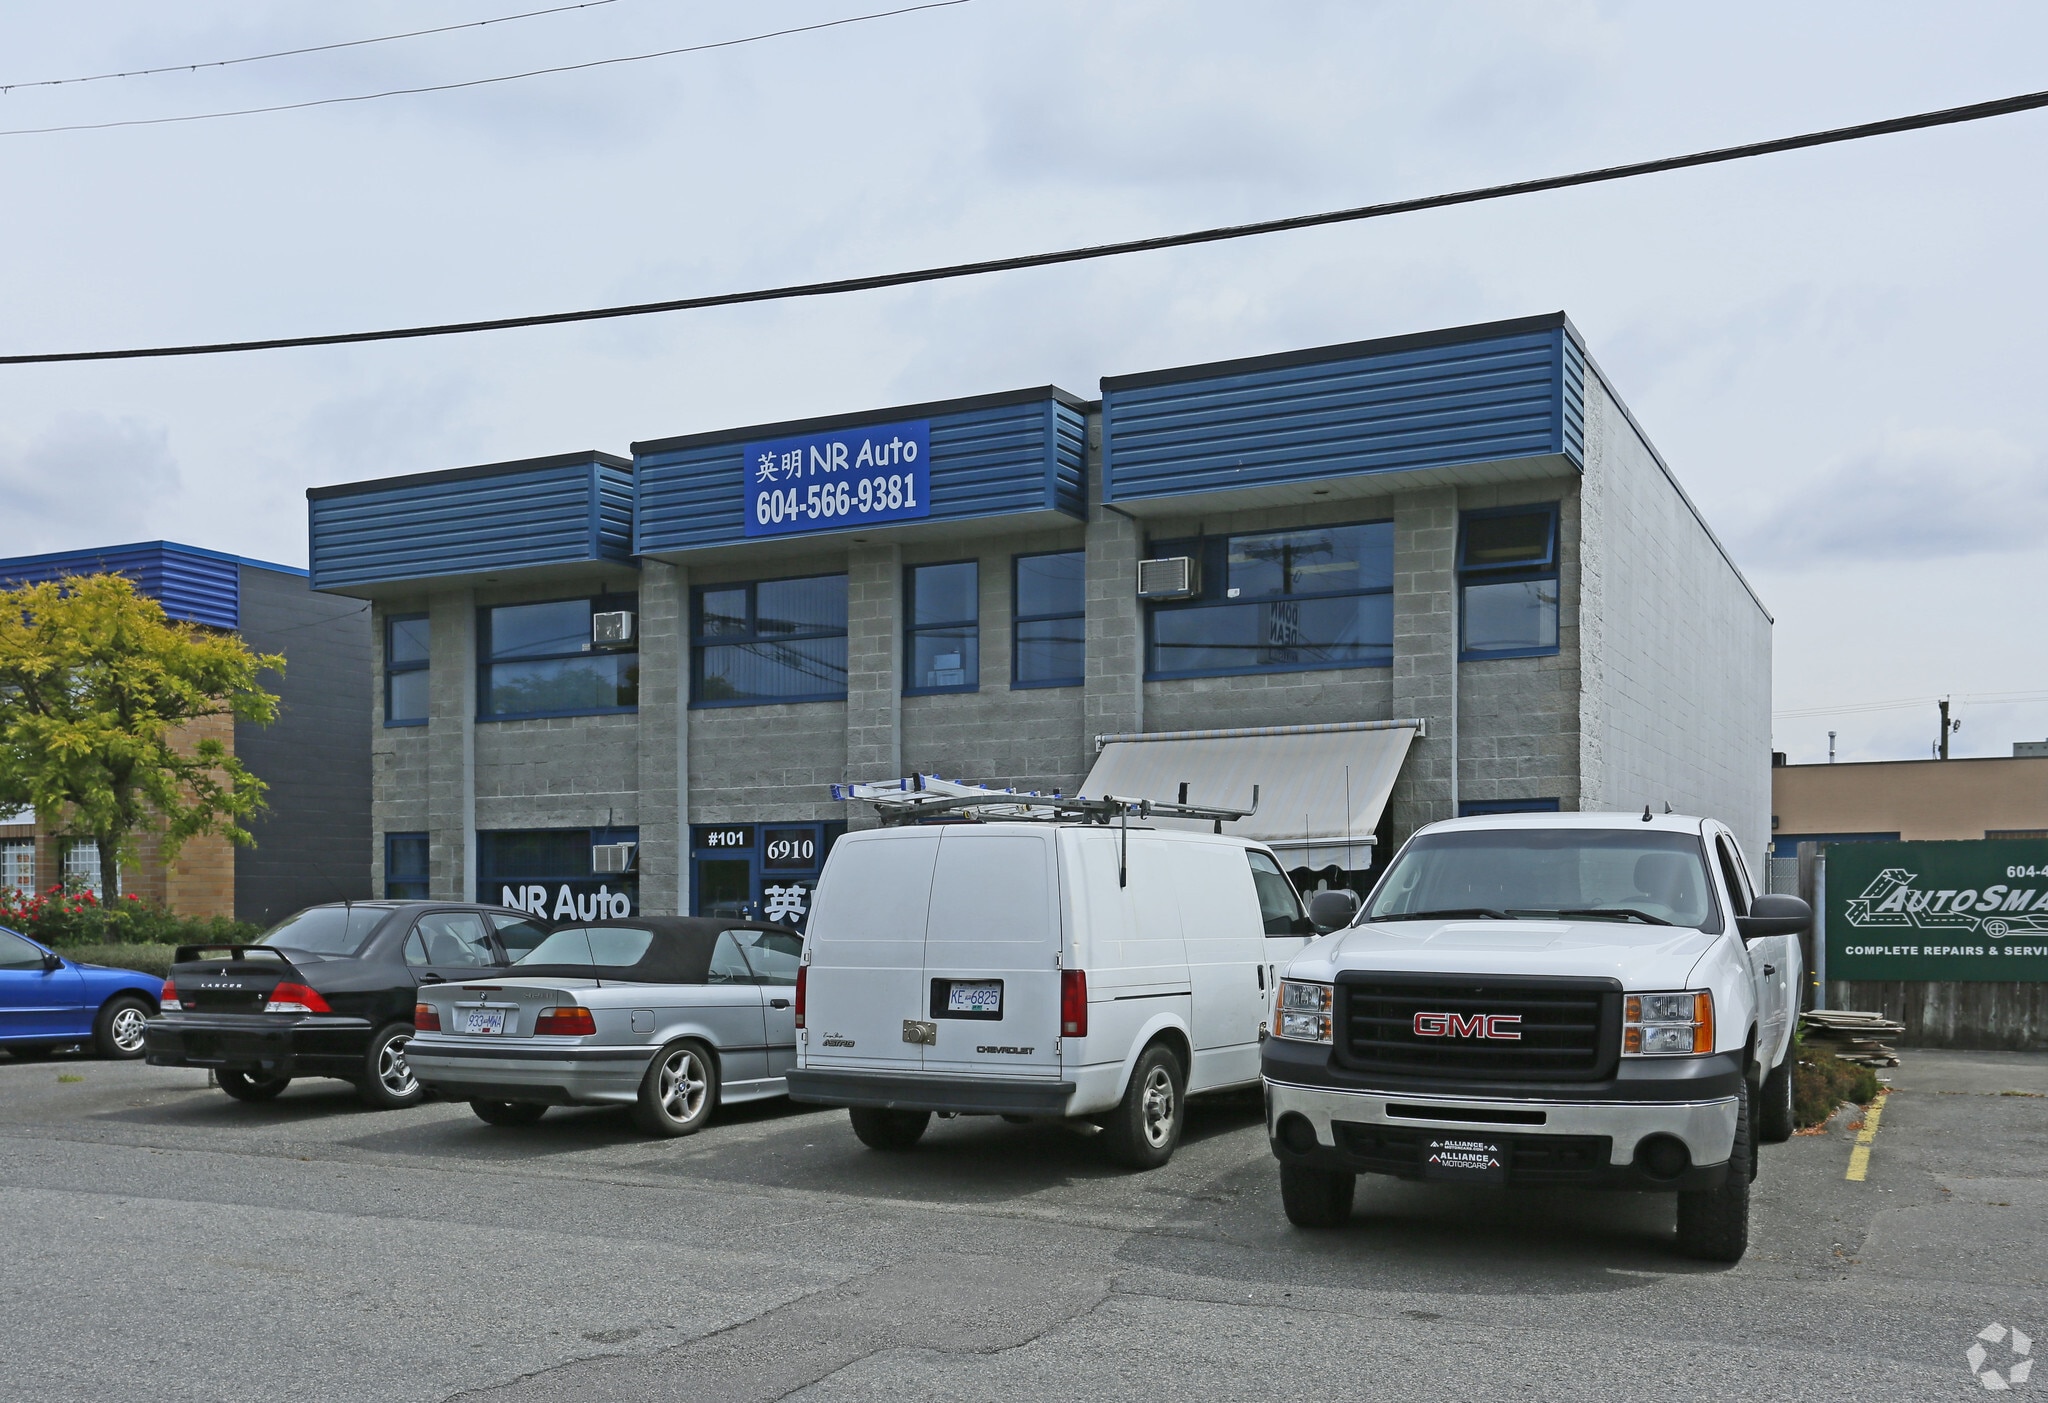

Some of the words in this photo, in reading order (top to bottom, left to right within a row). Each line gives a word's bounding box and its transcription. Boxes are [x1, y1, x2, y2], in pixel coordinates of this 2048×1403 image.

[810, 442, 849, 476] NR
[855, 436, 918, 469] Auto
[756, 449, 802, 484] 英明
[756, 472, 917, 525] 604-566-9381
[708, 831, 744, 847] #101
[767, 839, 814, 860] 6910
[502, 885, 548, 919] NR
[552, 884, 631, 921] Auto
[764, 884, 817, 923] 英
[1845, 946, 1919, 956] COMPLETE
[1923, 946, 1984, 956] REPAIRS
[1988, 946, 1999, 956] &
[2004, 946, 2048, 956] SERVI
[970, 990, 998, 1005] 6825
[1413, 1012, 1522, 1040] GMC
[976, 1045, 1035, 1055] CHEVROLET
[1444, 1140, 1484, 1148] ALLIANCE
[1440, 1152, 1489, 1162] ALLIANCE
[1441, 1160, 1487, 1170] MOTORCARS
